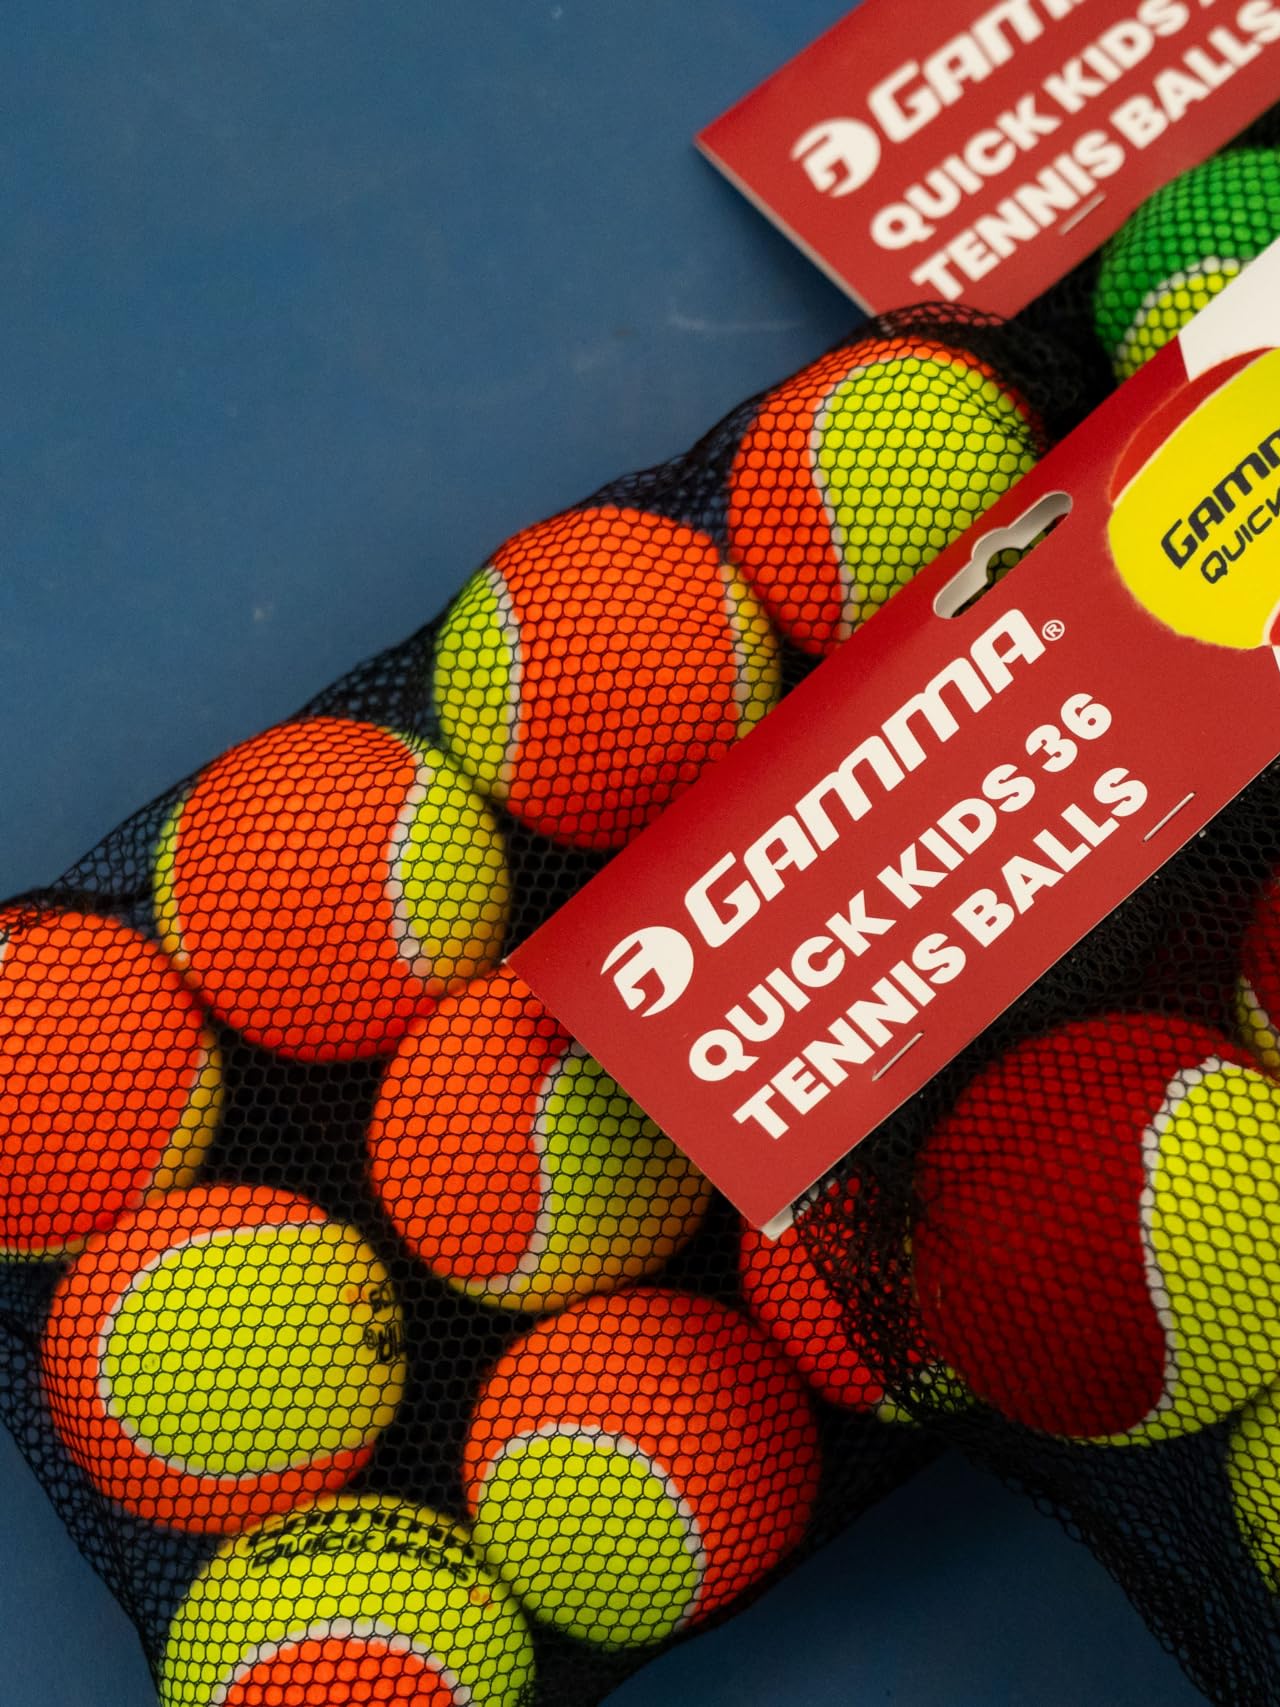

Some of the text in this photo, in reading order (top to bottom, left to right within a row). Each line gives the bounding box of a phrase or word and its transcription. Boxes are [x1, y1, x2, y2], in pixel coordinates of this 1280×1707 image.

[871, 0, 1189, 249] QUICK KIDS
[911, 132, 1125, 300] TENNIS
[688, 693, 1112, 1082] QUICK KIDS 36
[732, 767, 1148, 1140] TENNIS BALLS
